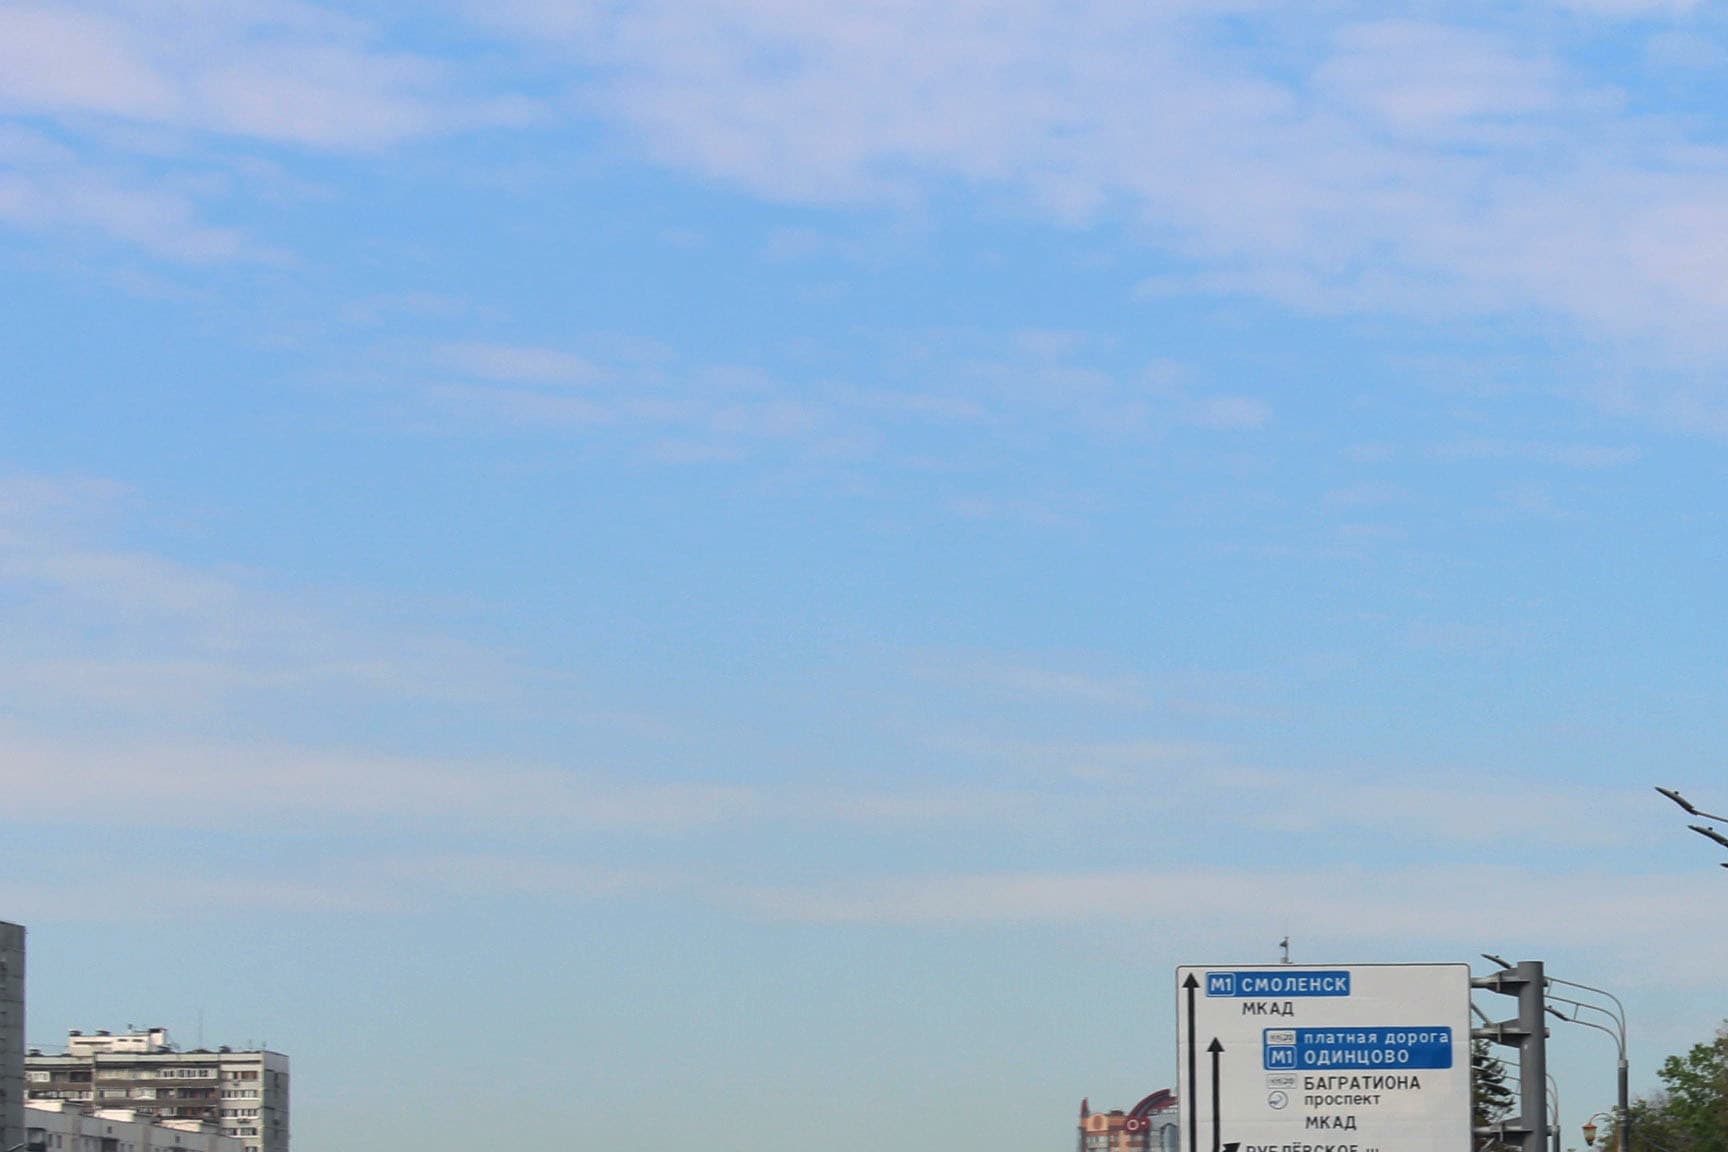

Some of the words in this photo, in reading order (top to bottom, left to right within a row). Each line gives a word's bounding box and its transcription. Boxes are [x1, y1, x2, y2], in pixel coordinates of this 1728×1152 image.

[1210, 978, 1233, 992] М1
[1241, 977, 1347, 992] СМОЛЕНСК
[1242, 1001, 1294, 1017] МКАД
[1304, 1032, 1377, 1045] платная
[1384, 1032, 1449, 1047] дорога
[1271, 1051, 1293, 1064] М1
[1304, 1049, 1409, 1066] ОДИНЦОВО
[1304, 1076, 1421, 1091] БАГРАТИОНА
[1304, 1094, 1381, 1107] проспект
[1305, 1116, 1357, 1131] МКАД
